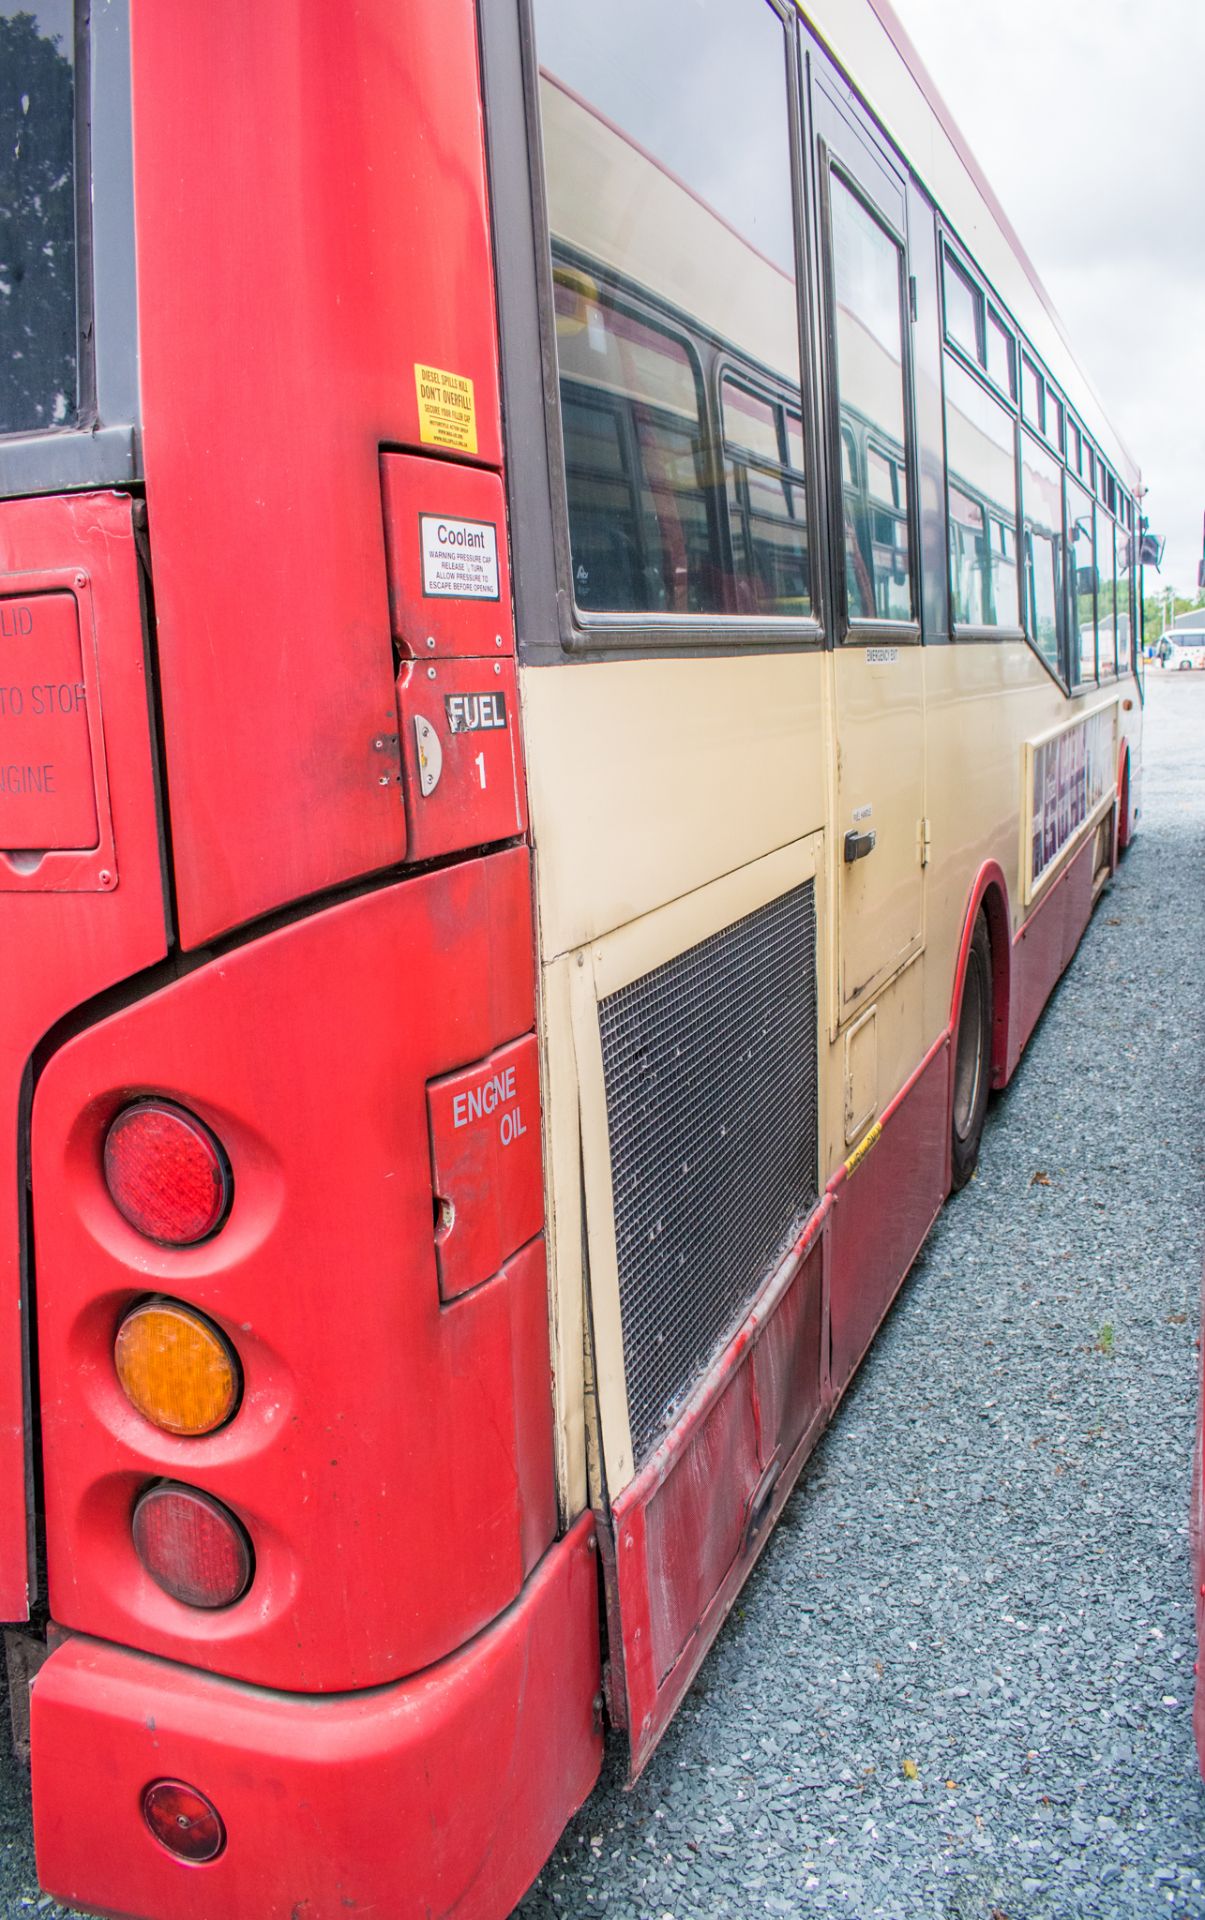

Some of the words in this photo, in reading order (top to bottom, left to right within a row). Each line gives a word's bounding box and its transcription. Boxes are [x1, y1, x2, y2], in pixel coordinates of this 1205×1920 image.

[421, 369, 440, 384] DIESEL
[421, 384, 440, 402] DON'T
[443, 389, 471, 410] OVERFILL!
[437, 524, 485, 549] Coolant
[429, 551, 456, 561] WARNING
[457, 553, 481, 563] PRESSURE
[441, 562, 464, 571] RELEASE
[429, 581, 452, 590] ESCAPE
[453, 582, 473, 591] BEFORE
[473, 584, 494, 593] OPENING
[436, 571, 455, 580] ALLOW
[456, 573, 481, 583] PRESSURE
[482, 575, 488, 583] TO
[1, 607, 33, 636] LID
[449, 695, 504, 733] FUEL
[475, 751, 486, 789] 1
[453, 1066, 516, 1128] ENGNE
[500, 1106, 527, 1146] OIL
